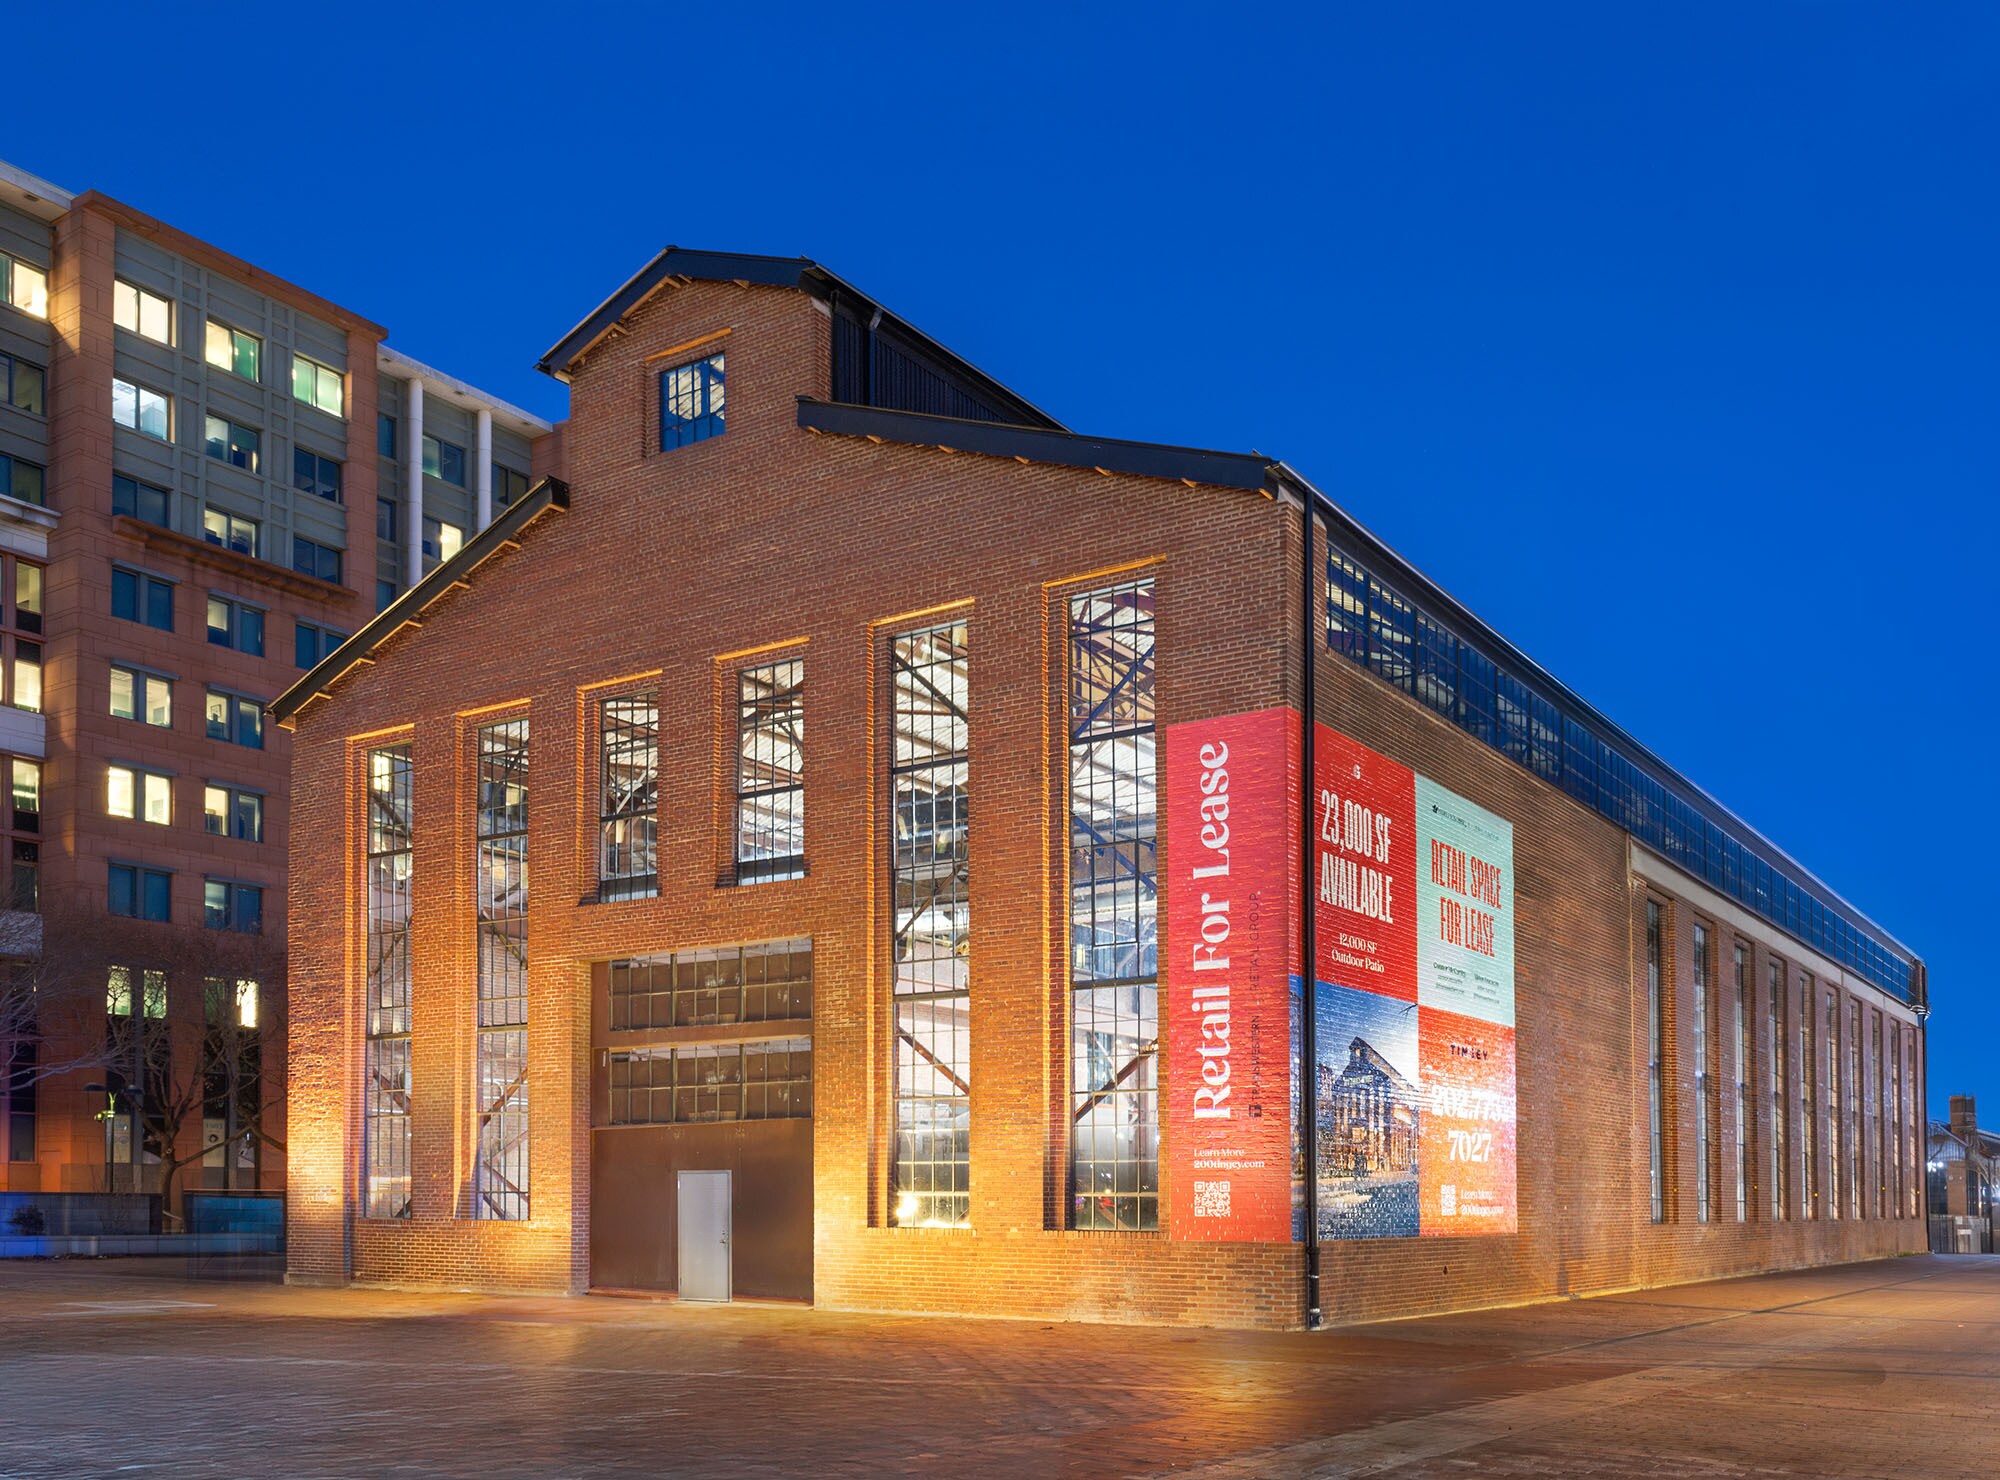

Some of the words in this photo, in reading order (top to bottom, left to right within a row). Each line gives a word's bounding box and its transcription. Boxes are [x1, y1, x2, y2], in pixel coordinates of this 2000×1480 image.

[1192, 741, 1231, 880] Lease
[1321, 789, 1371, 857] 23,000
[1375, 812, 1392, 864] SF
[1321, 851, 1393, 924] AVAILABLE
[1431, 838, 1466, 895] RETAIL
[1470, 856, 1501, 909] SPACE
[1192, 893, 1231, 972] For
[1249, 891, 1259, 940] GROUP
[1339, 932, 1364, 950] 12,000
[1366, 942, 1377, 953] SF
[1440, 897, 1461, 946] FOR
[1464, 909, 1495, 957] LEASE
[1331, 950, 1363, 969] Outdoor
[1365, 957, 1384, 973] Patio
[1192, 986, 1231, 1120] Retail
[1194, 1148, 1219, 1157] Learn
[1194, 1159, 1265, 1170] 200tingey.com
